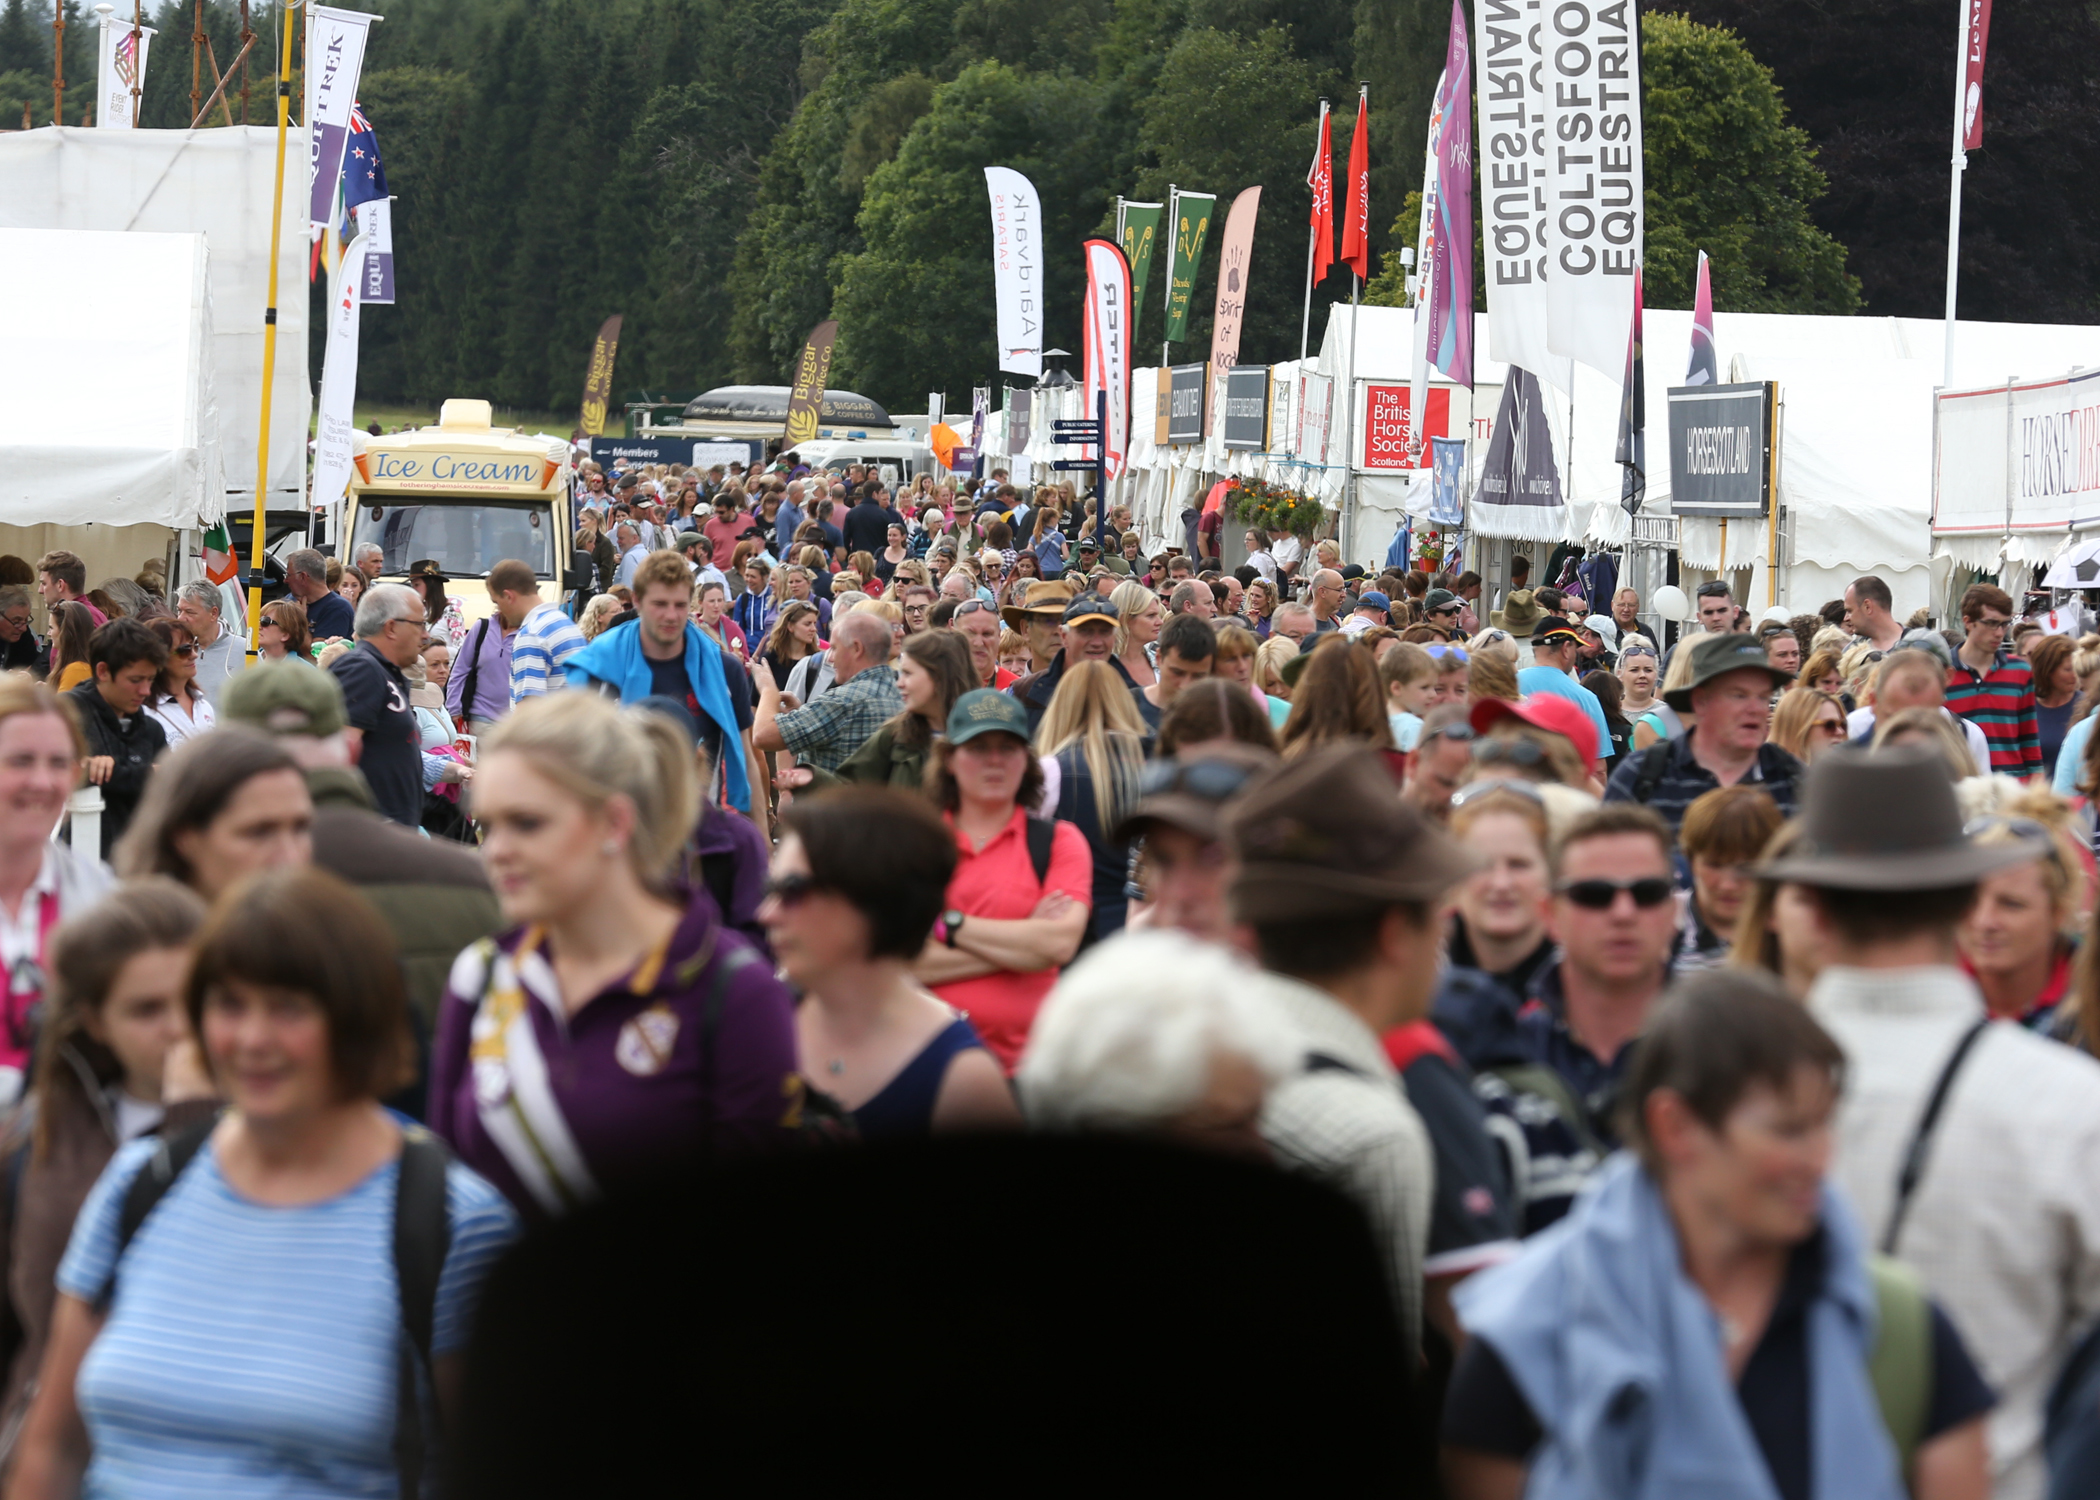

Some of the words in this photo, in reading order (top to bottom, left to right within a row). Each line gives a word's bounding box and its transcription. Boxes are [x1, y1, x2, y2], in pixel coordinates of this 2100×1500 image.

[1219, 298, 1242, 319] Spirit
[1220, 324, 1231, 342] of
[795, 342, 817, 400] Biggar
[814, 365, 828, 403] Coffee
[821, 345, 831, 362] Co
[833, 401, 873, 411] BIGGAR
[1376, 391, 1398, 404] The
[1374, 405, 1411, 420] Britis
[1373, 421, 1411, 437] Hors
[612, 447, 659, 458] Members
[1687, 425, 1751, 476] HORSESCOTLAND
[374, 453, 424, 478] Ice
[432, 455, 538, 482] Cream
[1371, 457, 1407, 467] Scotland
